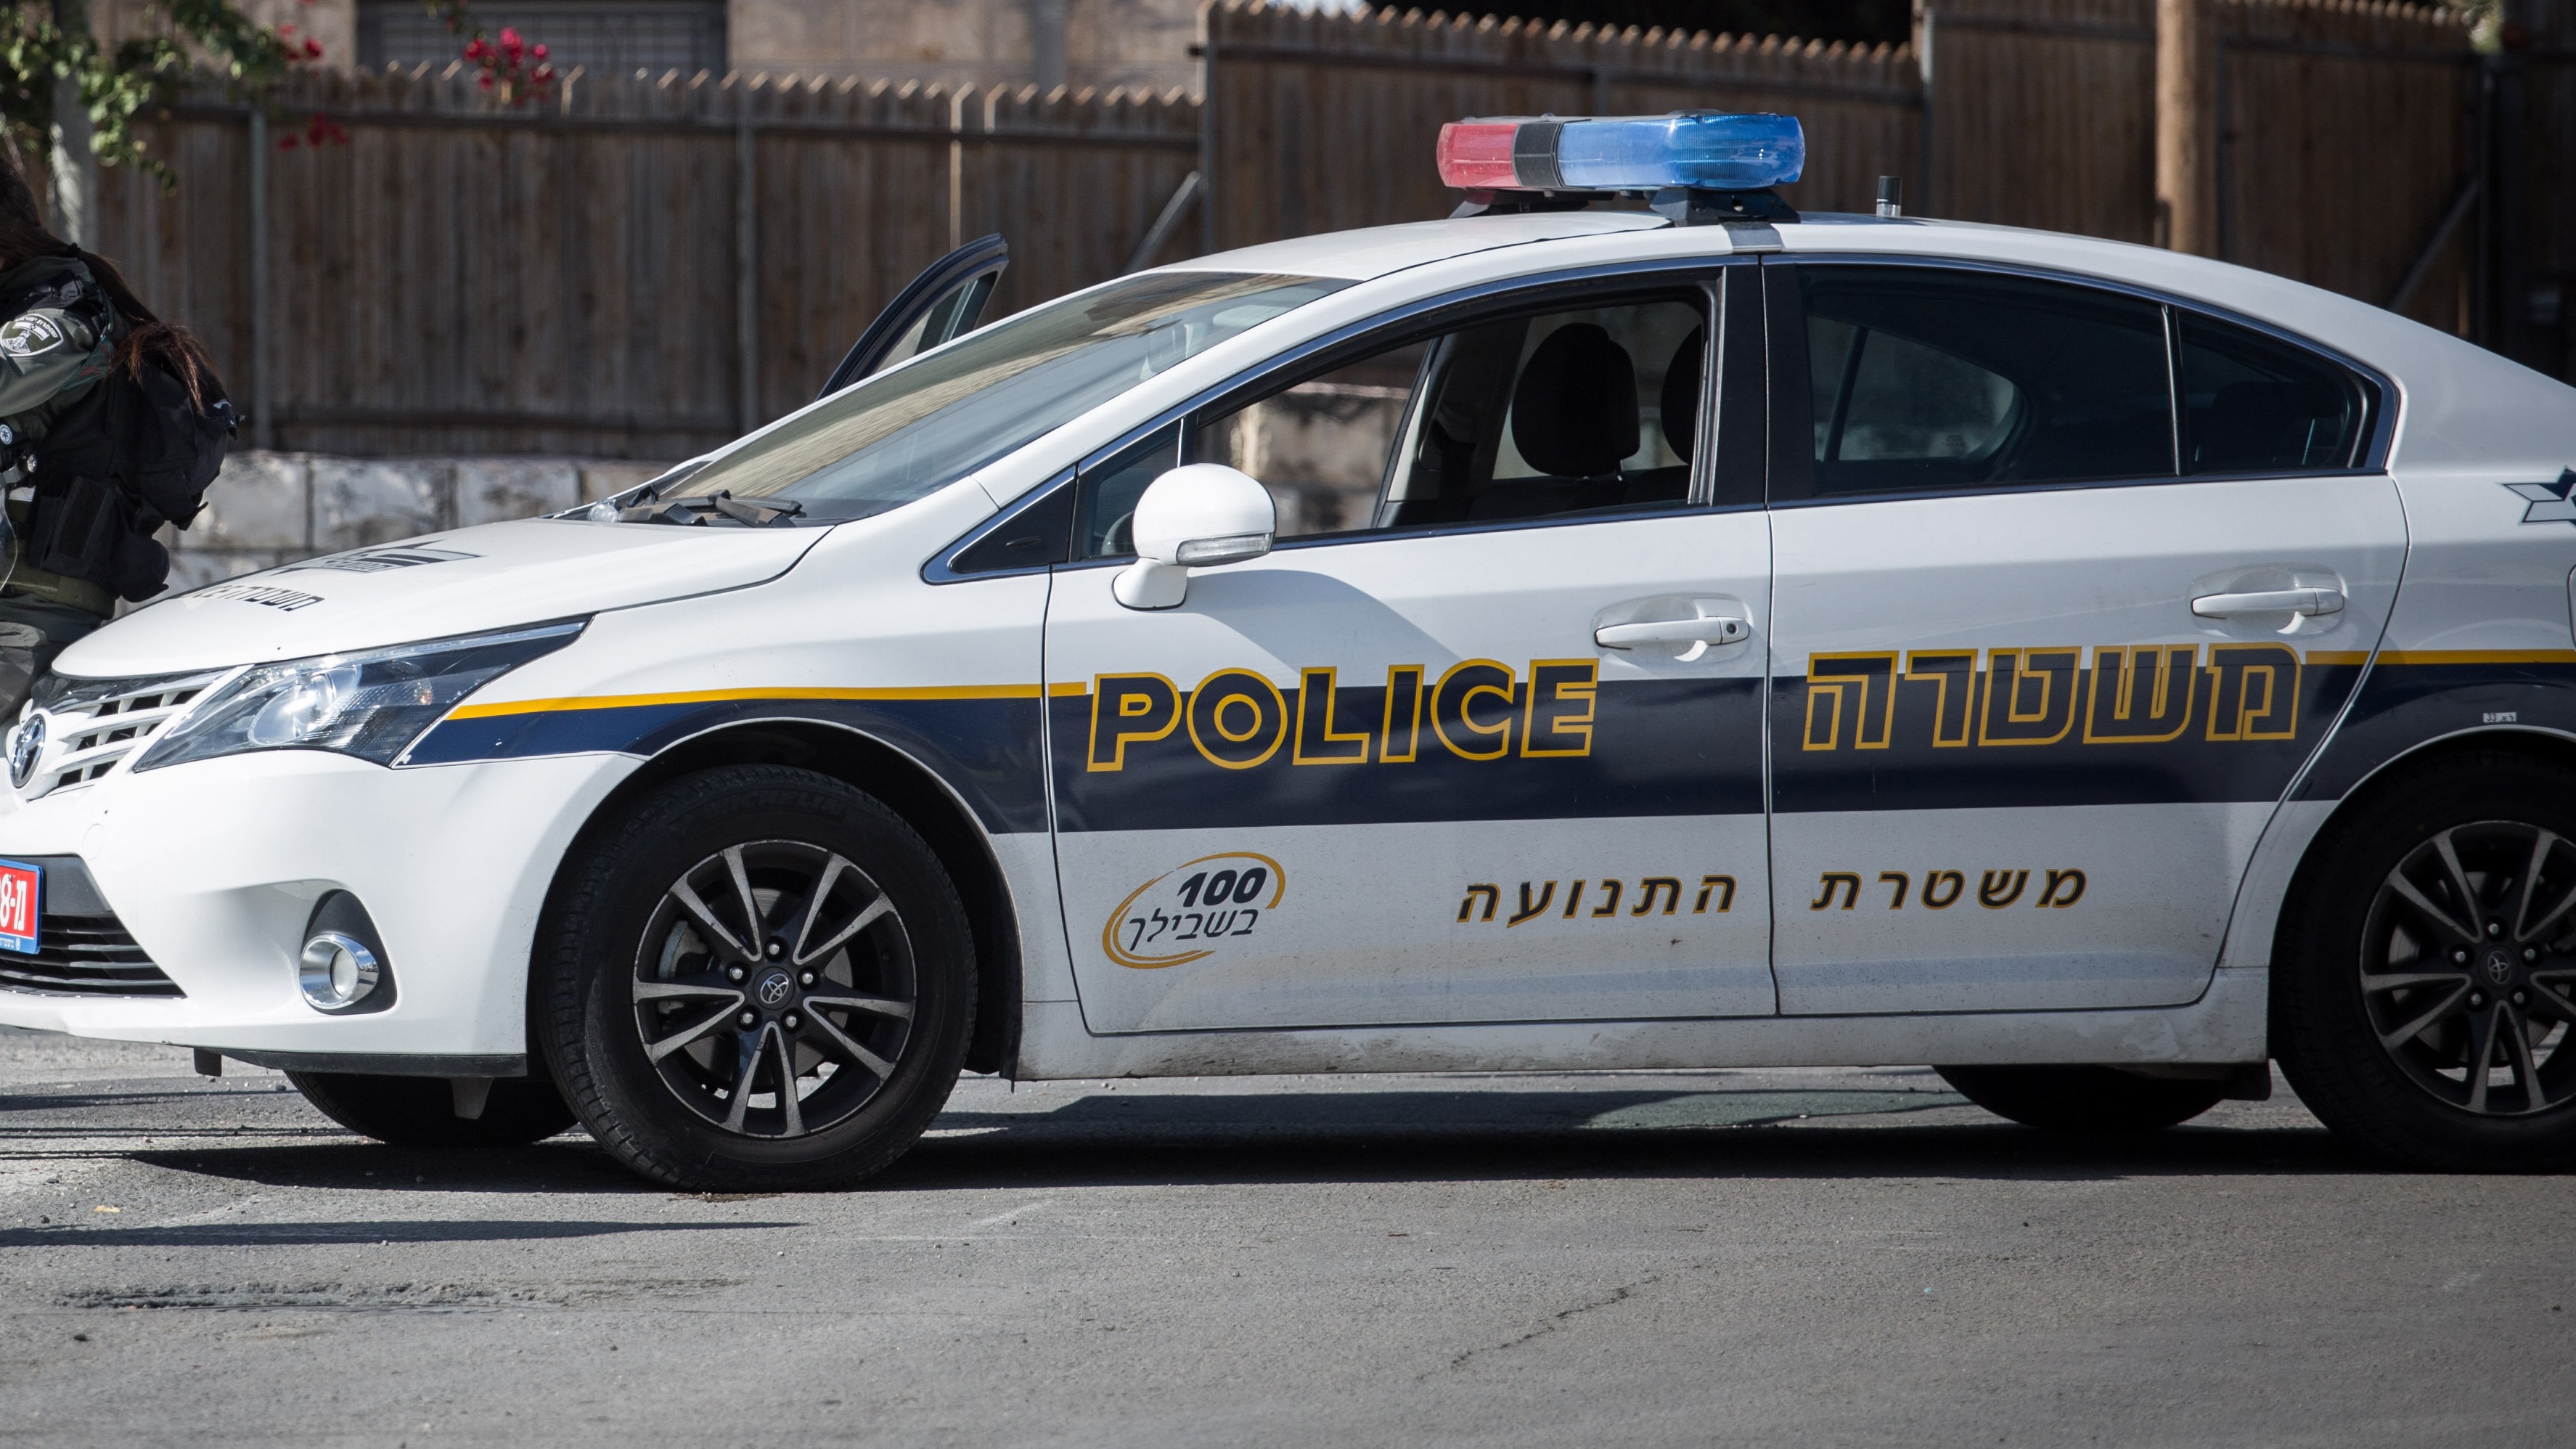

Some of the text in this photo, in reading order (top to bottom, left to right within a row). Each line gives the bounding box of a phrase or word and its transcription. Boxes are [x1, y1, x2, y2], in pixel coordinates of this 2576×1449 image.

[1087, 658, 1600, 772] POLICE
[1802, 641, 2302, 751] משטרה
[1177, 867, 1267, 907] 100
[1456, 868, 2088, 928] משטרת התנועה
[1129, 907, 1259, 951] בשבילך
